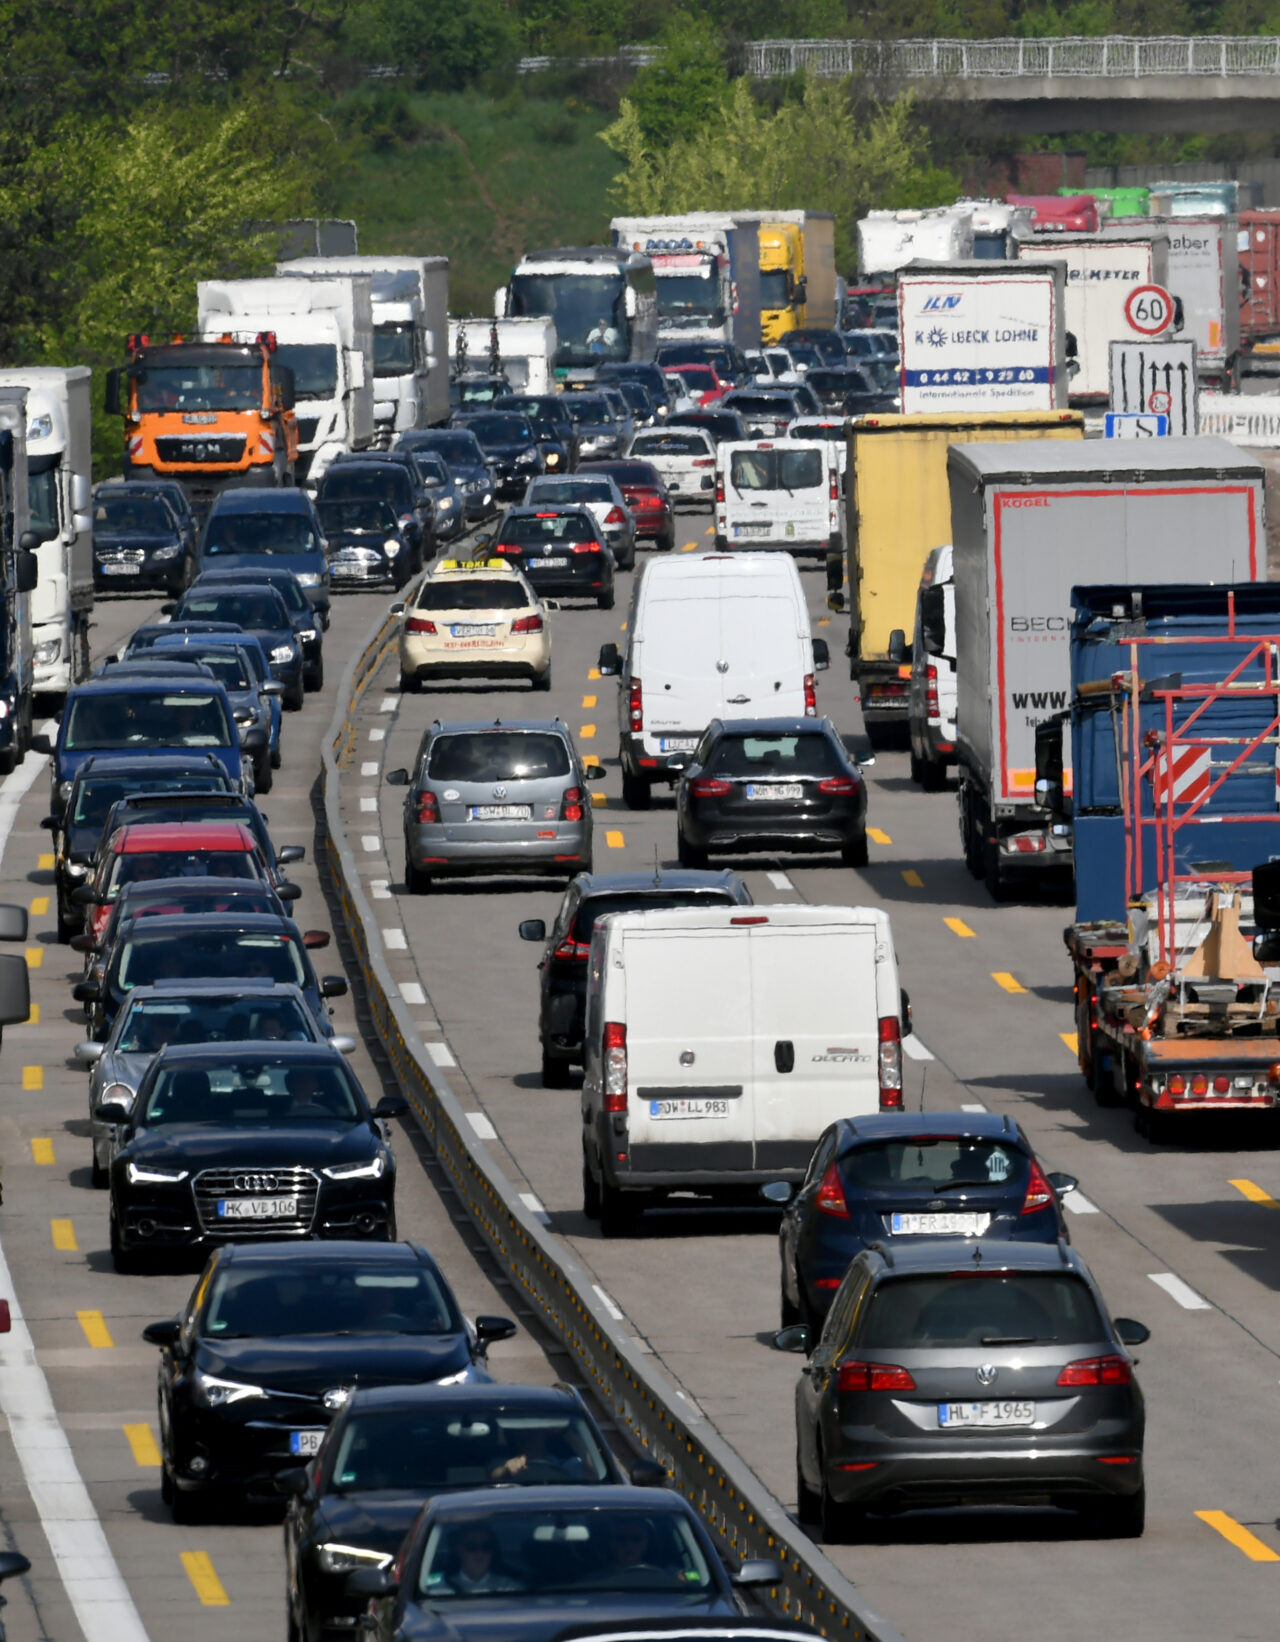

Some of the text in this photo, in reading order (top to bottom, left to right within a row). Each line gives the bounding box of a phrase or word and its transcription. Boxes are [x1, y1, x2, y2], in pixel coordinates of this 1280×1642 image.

[1136, 298, 1163, 321] 60
[995, 328, 1039, 343] LOHNE
[953, 371, 969, 383] 42
[460, 560, 485, 569] TAXI
[704, 1101, 727, 1113] 983
[226, 1200, 242, 1215] HK
[949, 1402, 1032, 1420] HL F 1965
[301, 1434, 317, 1451] PB
